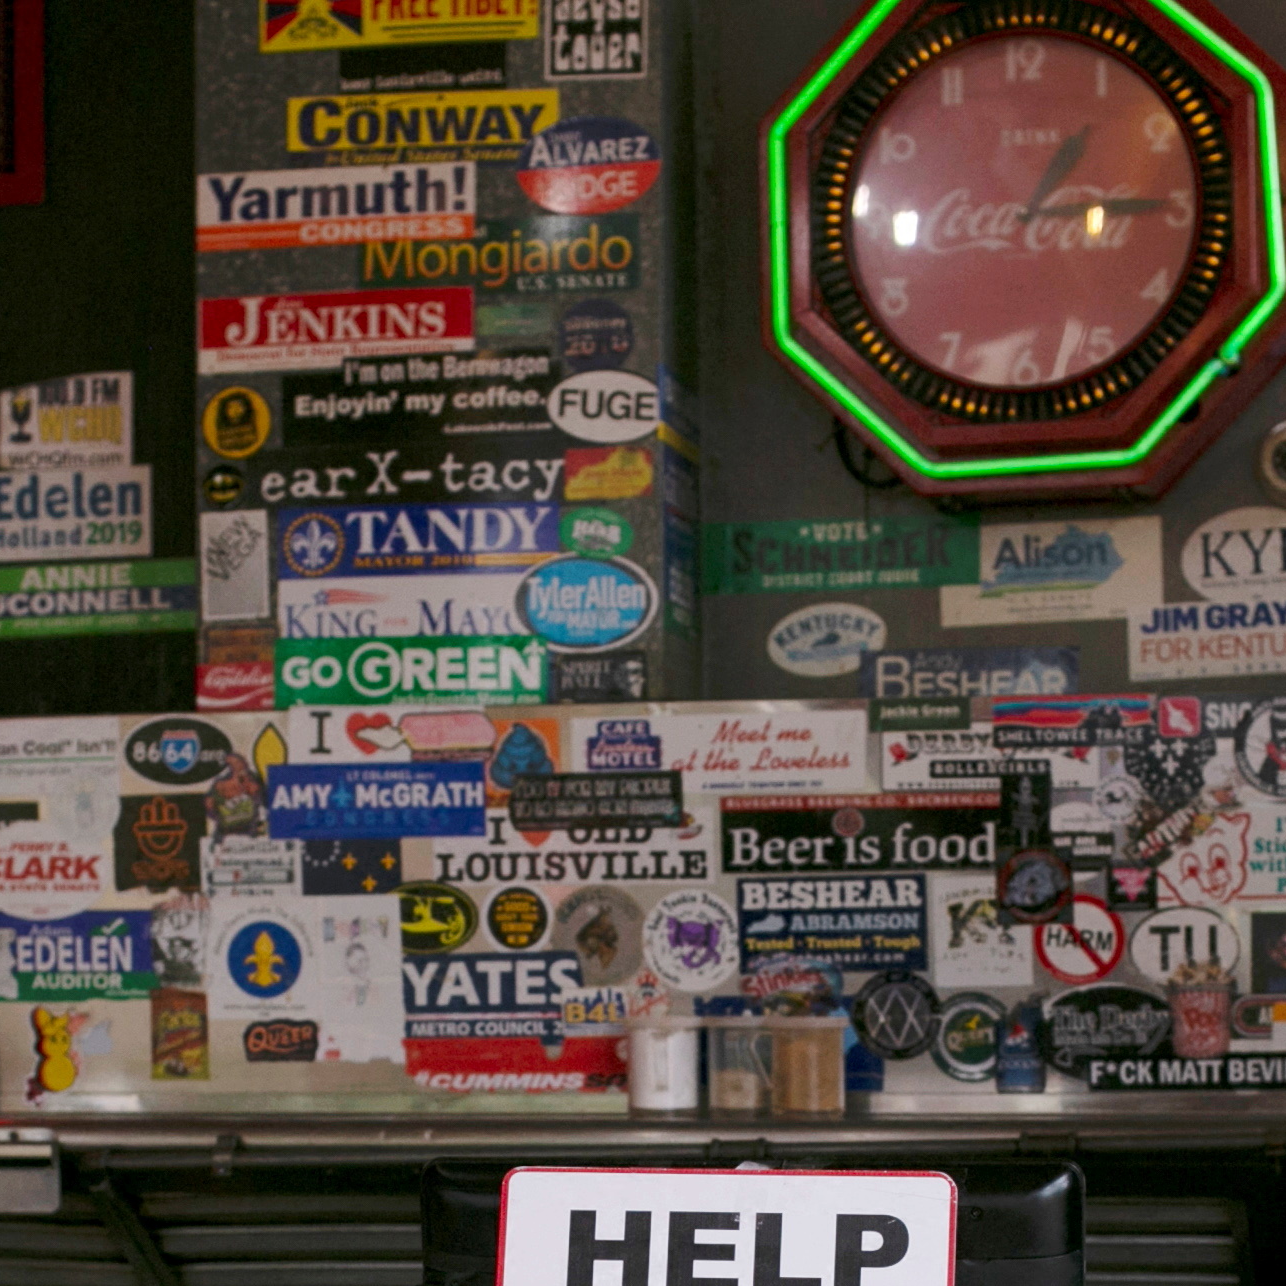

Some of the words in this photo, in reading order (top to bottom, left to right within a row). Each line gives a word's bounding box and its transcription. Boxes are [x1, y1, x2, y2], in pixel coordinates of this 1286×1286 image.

[1006, 40, 1046, 82] 12
[1096, 59, 1108, 97] 1
[299, 100, 546, 149] CONWAY
[1143, 113, 1172, 152] 2
[528, 133, 651, 168] ALVAREZ
[880, 126, 916, 164] 10
[209, 166, 467, 222] Yarmuth!
[1166, 190, 1192, 228] 3
[299, 217, 467, 243] CONGRESS
[363, 225, 633, 287] Mongiardo
[557, 271, 629, 289] SENATE
[881, 277, 910, 317] 8
[1140, 268, 1168, 303] 4
[224, 297, 447, 345] JENKINS
[939, 331, 962, 369] 7
[1088, 326, 1116, 362] 5
[381, 362, 404, 383] on
[408, 359, 439, 381] the
[1015, 349, 1040, 385] 6
[294, 390, 398, 421] Enjoyin'
[405, 391, 446, 417] my
[452, 383, 548, 410] coffee.
[558, 388, 658, 421] FUGE
[260, 467, 357, 502] ear
[364, 450, 565, 502] X-tacy
[86, 519, 143, 545] 2019
[346, 507, 551, 555] TANDY
[812, 522, 869, 542] VOTE
[353, 554, 425, 568] MAYOR
[731, 522, 951, 576] SCHNEIDER
[994, 537, 1109, 571] Alison
[20, 563, 131, 590] ANNIE
[285, 604, 378, 639] KING
[772, 614, 882, 648] KENTUCKY
[1141, 608, 1200, 634] JIM
[1139, 640, 1191, 664] FOR
[282, 657, 343, 688] GO
[347, 643, 542, 698] GREEN
[874, 655, 1069, 699] BESHEAR
[309, 711, 331, 754] I
[599, 720, 647, 737] CAFE
[710, 719, 769, 745] Meet
[776, 728, 813, 742] me
[996, 727, 1090, 743] SHELTOWEE
[1095, 726, 1145, 741] TRACE
[590, 754, 658, 768] MOTEL
[702, 750, 741, 772] the
[750, 747, 851, 772] Loveless
[271, 783, 334, 810] AMY
[354, 780, 484, 809] McGRATH
[305, 810, 451, 828] CONGRESS
[728, 826, 835, 866] Beer
[842, 832, 882, 866] is
[891, 821, 996, 865] food
[436, 850, 708, 883] LOUISVILLE
[741, 879, 923, 911] BESHEAR
[788, 911, 921, 933] ABRAMSON
[17, 935, 133, 973] EDELEN
[803, 934, 863, 950] Trusted
[872, 934, 922, 951] Tough
[1046, 928, 1113, 952] HARM
[32, 972, 123, 991] AUDITOR
[402, 957, 585, 1007] YATES
[411, 1022, 470, 1037] METRO
[474, 1019, 549, 1036] COUNCIL
[427, 1072, 585, 1091] CUMMINS
[1158, 1058, 1223, 1084] MATT
